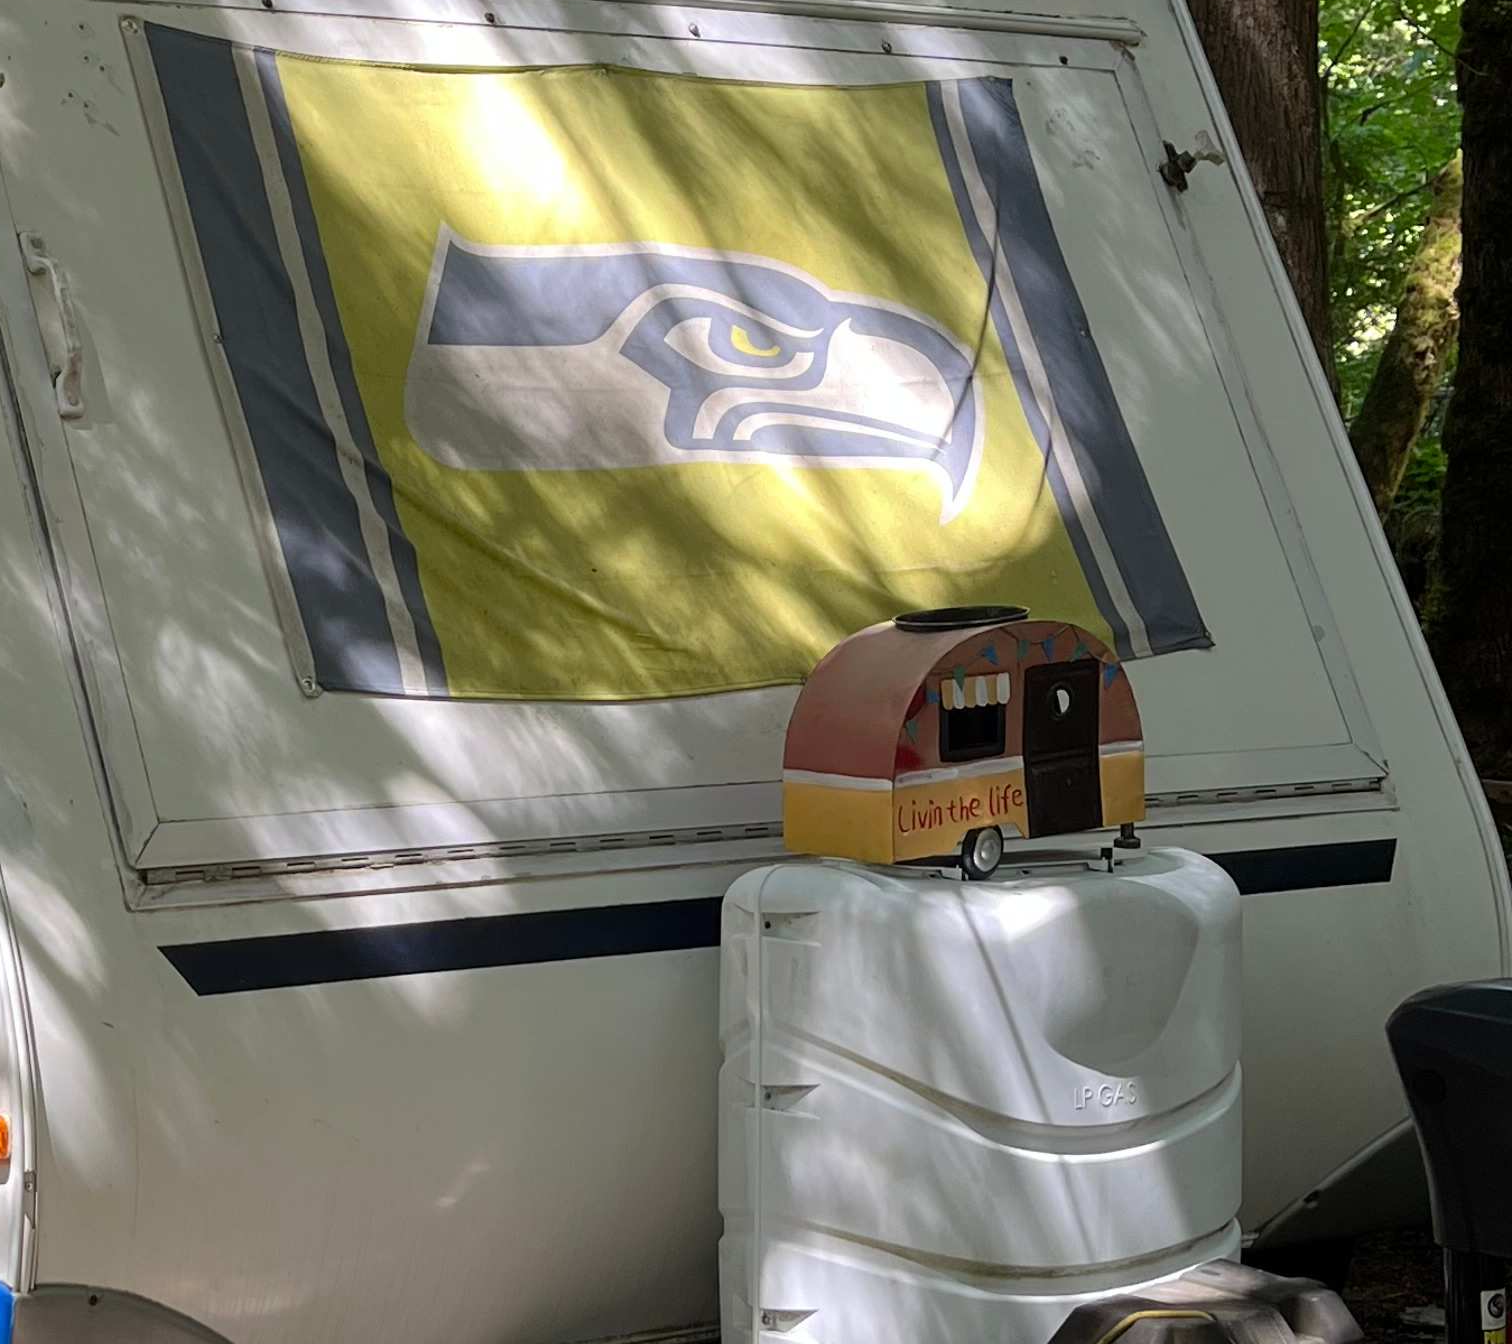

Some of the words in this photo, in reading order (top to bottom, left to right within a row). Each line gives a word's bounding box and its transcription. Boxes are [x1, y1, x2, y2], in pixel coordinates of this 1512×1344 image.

[898, 800, 943, 832] Livin
[947, 796, 981, 823] the
[989, 784, 1024, 816] life
[1073, 1086, 1093, 1110] LP
[1098, 1080, 1137, 1108] GAS
